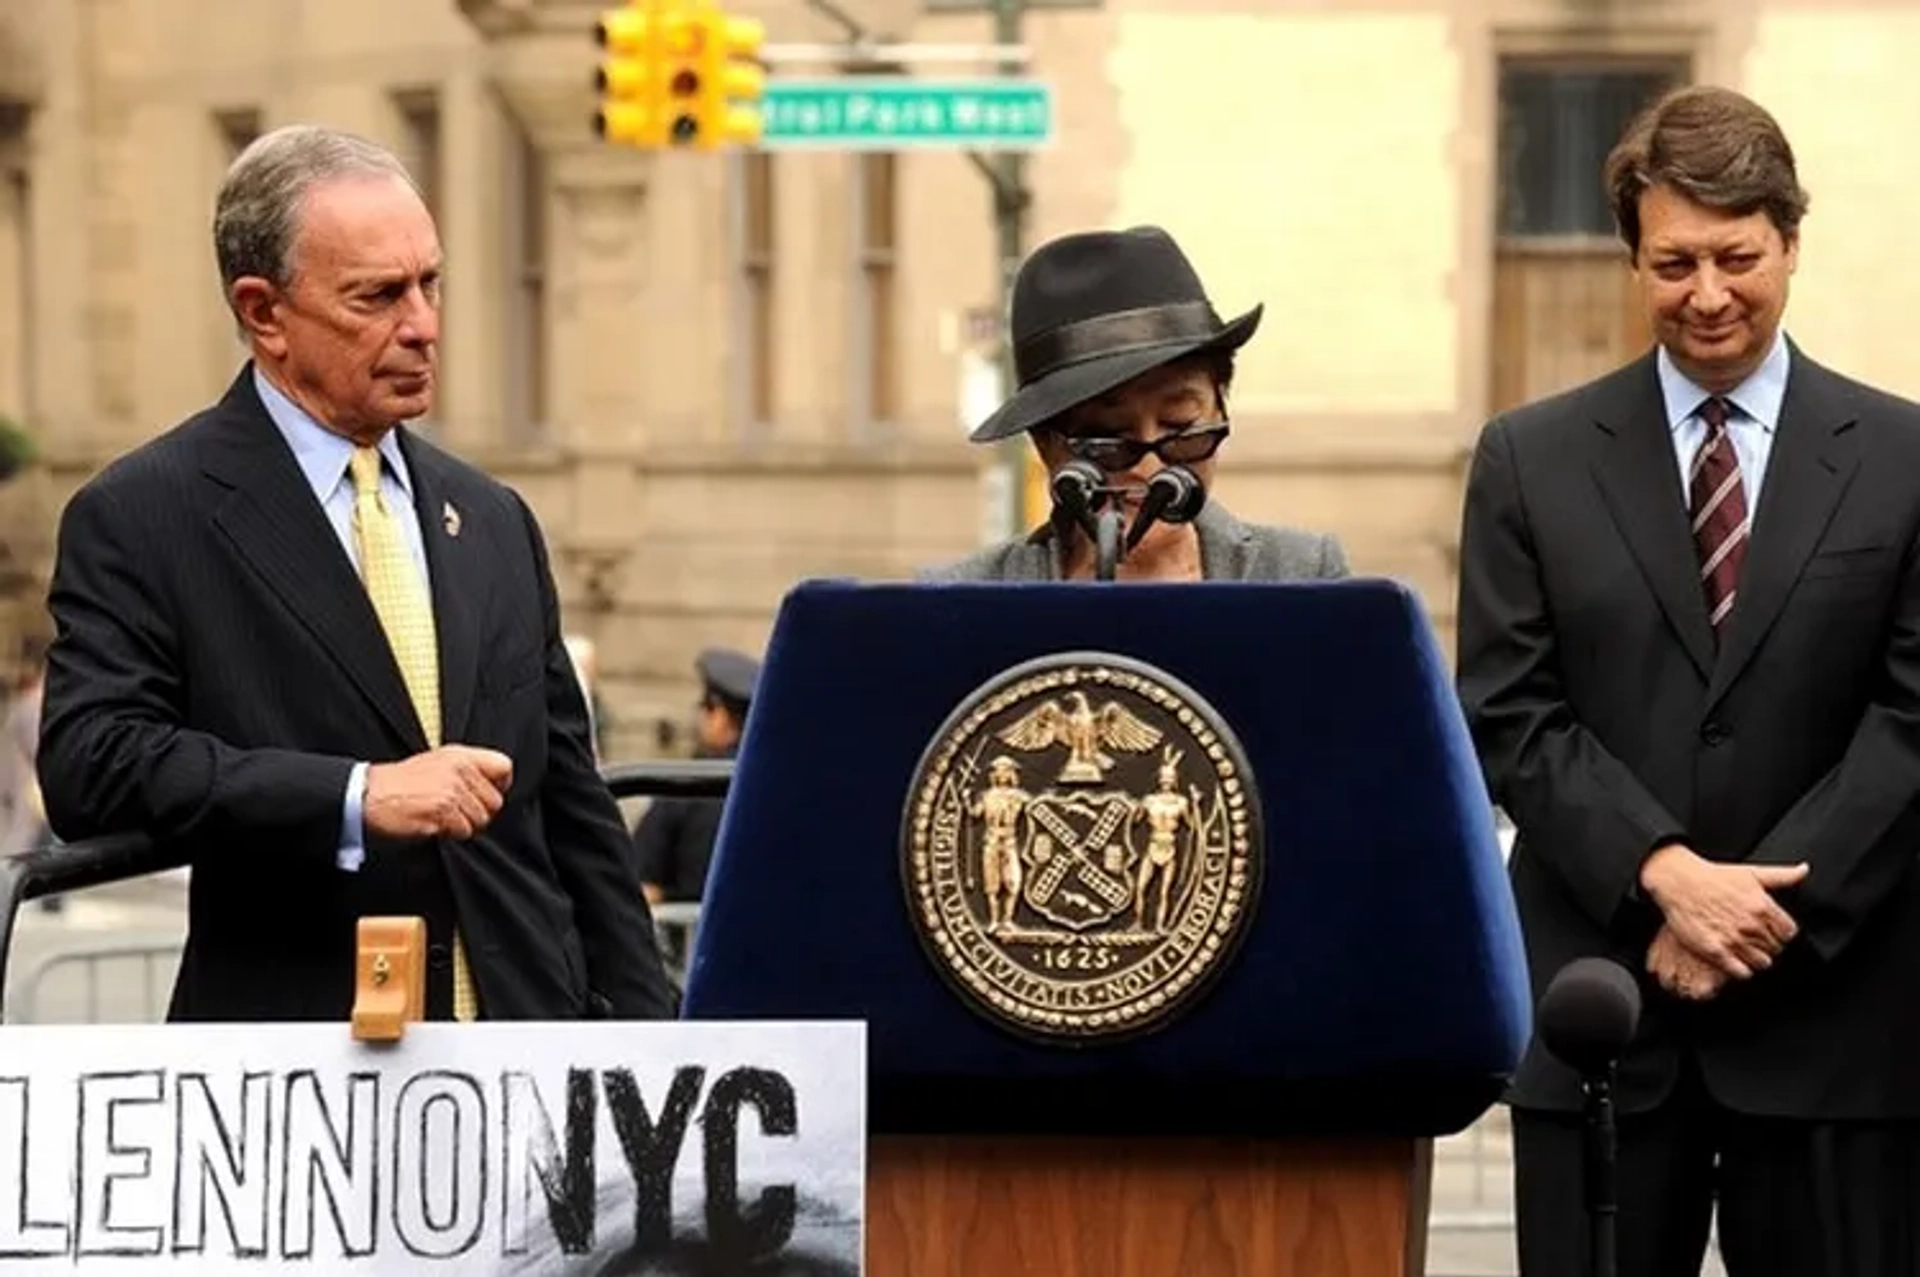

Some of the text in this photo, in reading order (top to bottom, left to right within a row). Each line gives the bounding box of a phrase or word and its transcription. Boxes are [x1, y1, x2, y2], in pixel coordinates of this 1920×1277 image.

[847, 97, 943, 131] Park
[952, 97, 1046, 131] West
[1044, 948, 1110, 970] 1625
[1106, 954, 1176, 1000] NOVI
[0, 1065, 799, 1264] LENNONYC
